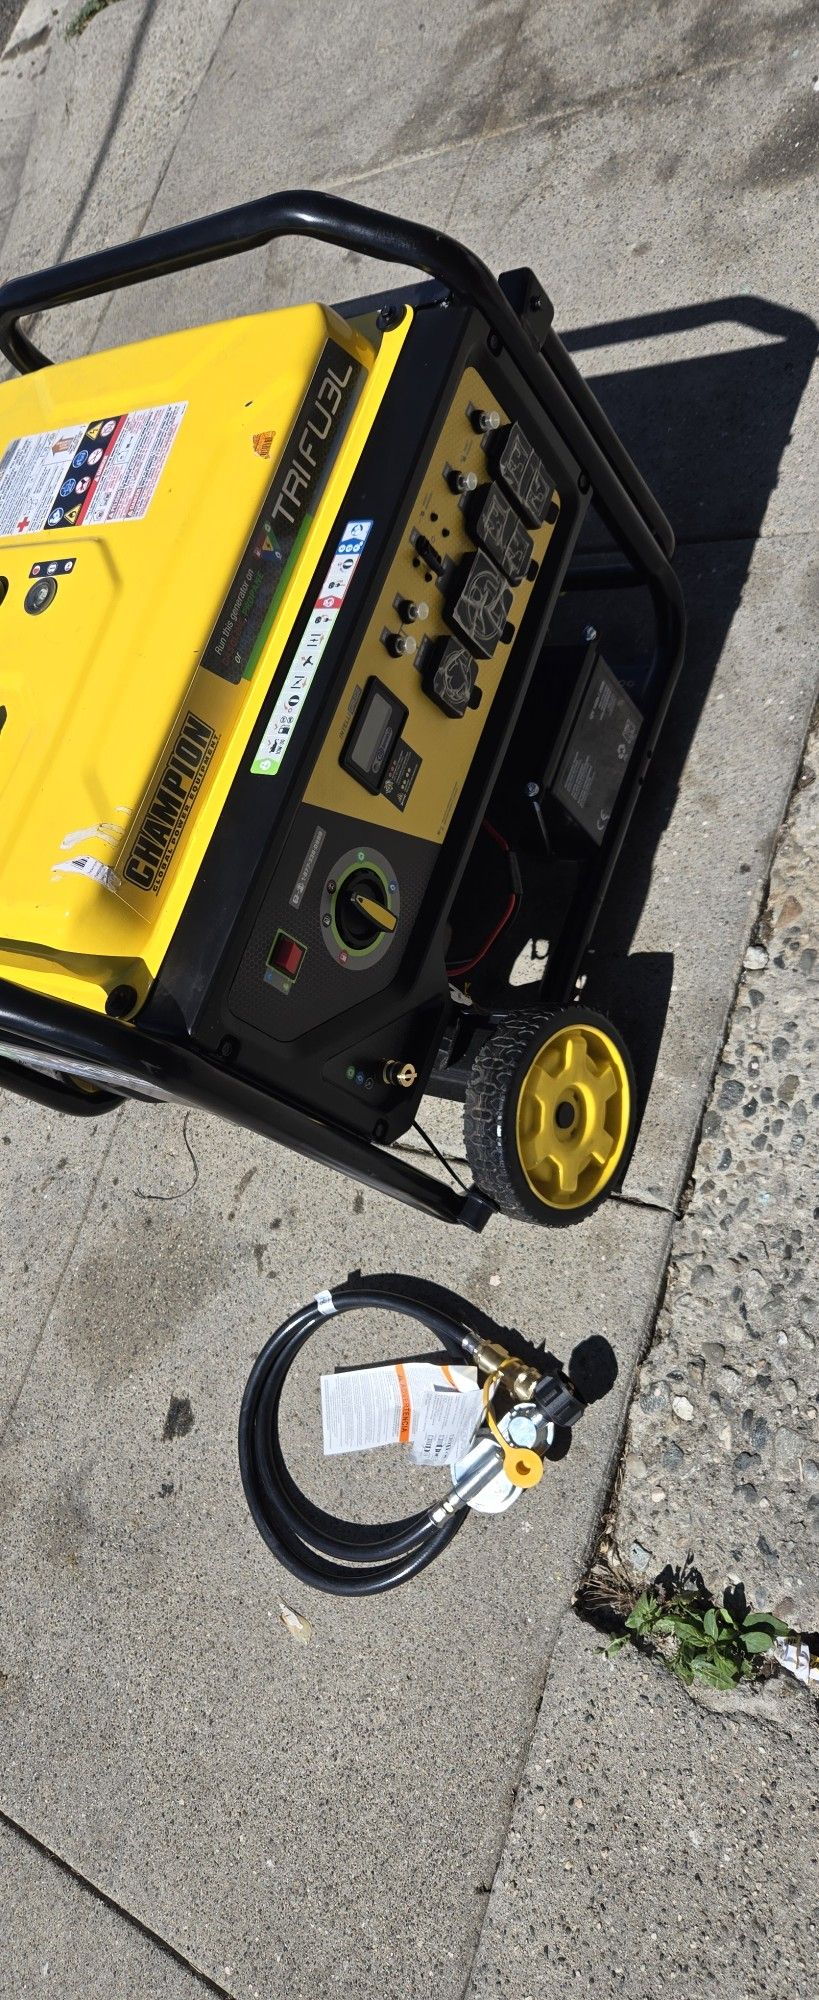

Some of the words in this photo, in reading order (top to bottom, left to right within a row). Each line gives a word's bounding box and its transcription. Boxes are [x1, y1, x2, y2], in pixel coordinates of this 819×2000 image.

[271, 459, 311, 524] TRI
[214, 637, 228, 655] Run
[222, 620, 234, 637] this
[230, 582, 250, 621] generator
[246, 568, 254, 581] on
[234, 651, 242, 664] or
[124, 712, 214, 890] CHAMPION
[152, 846, 173, 892] GLOBAL
[171, 804, 191, 844] POWER
[189, 734, 220, 800] EQUIPMENT
